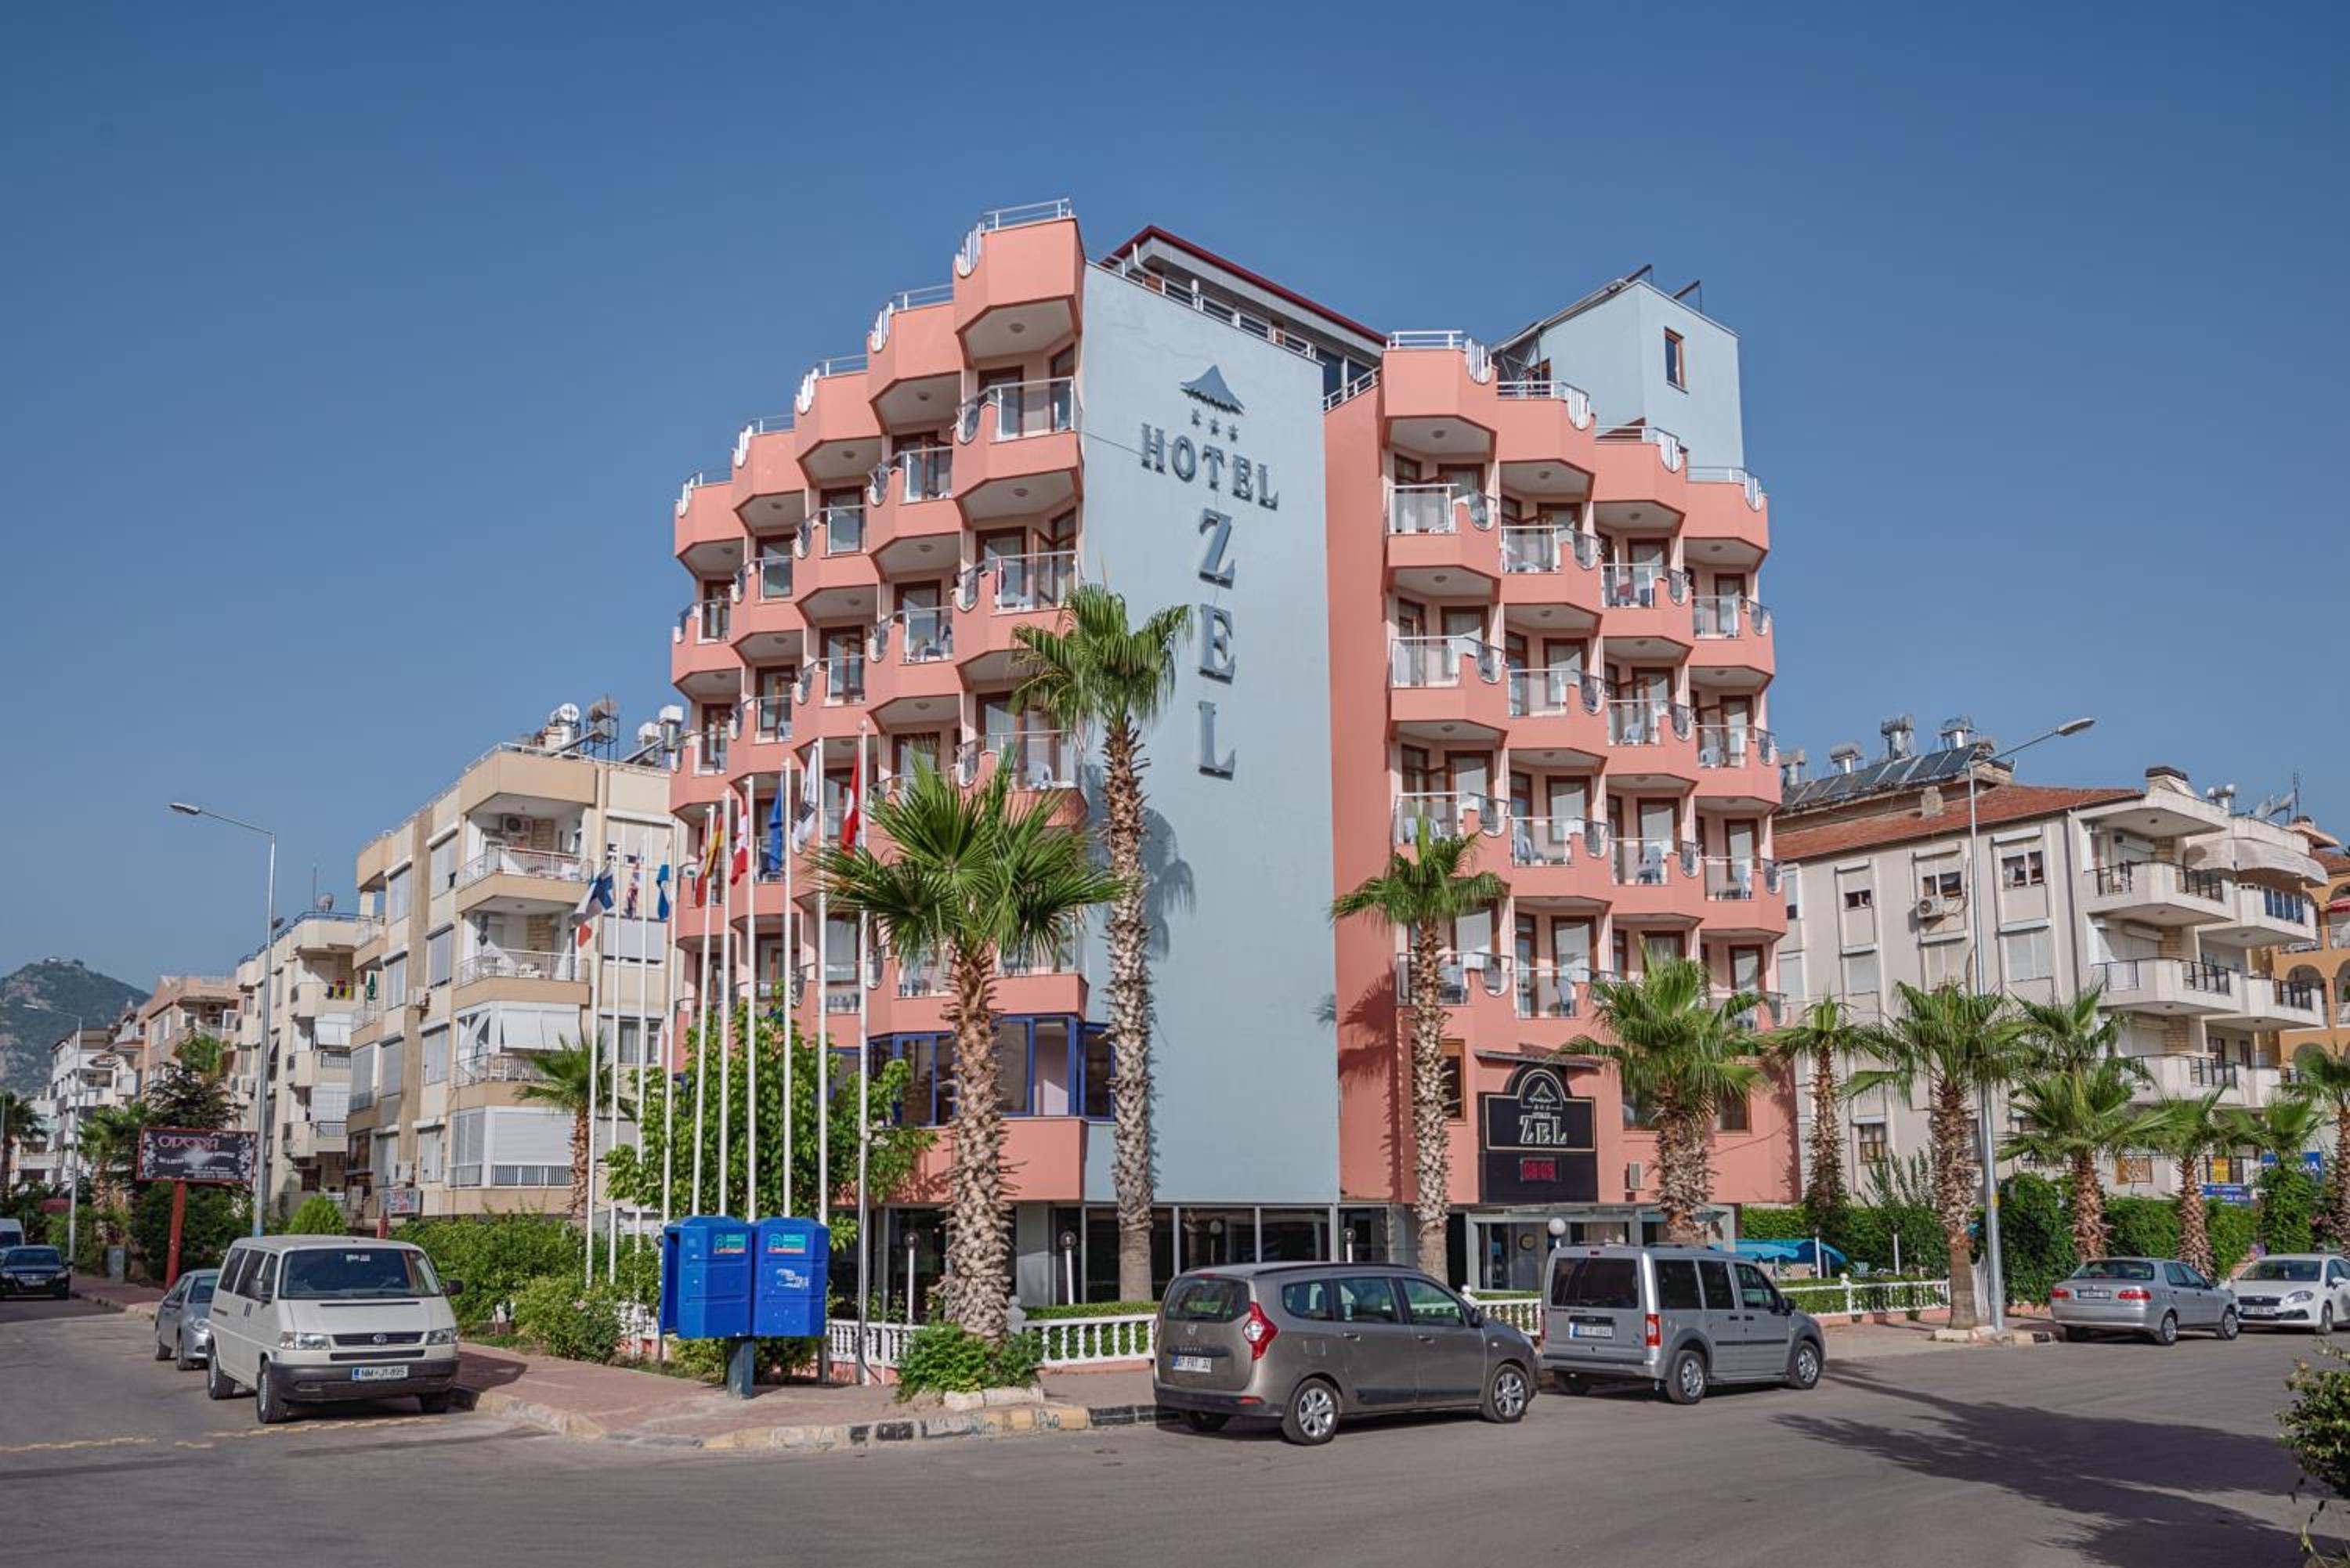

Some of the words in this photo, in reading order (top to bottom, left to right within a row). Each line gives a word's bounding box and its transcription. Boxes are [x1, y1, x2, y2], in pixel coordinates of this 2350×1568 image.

[1141, 423, 1279, 511] HOTEL
[1198, 508, 1236, 780] ZEL
[1520, 1115, 1567, 1144] ZEL
